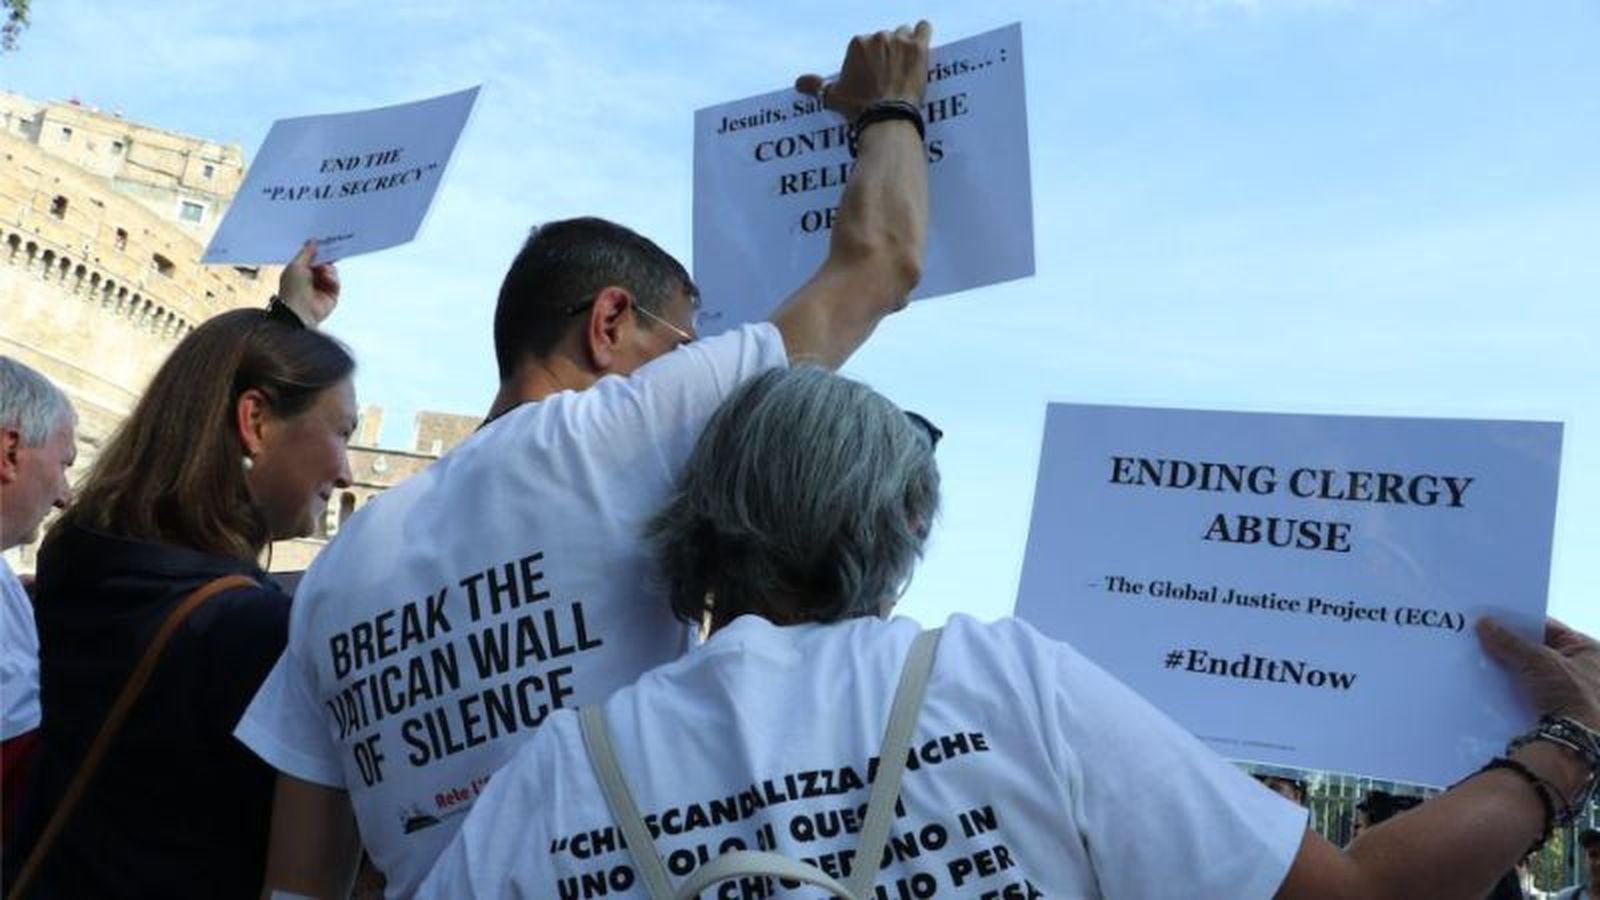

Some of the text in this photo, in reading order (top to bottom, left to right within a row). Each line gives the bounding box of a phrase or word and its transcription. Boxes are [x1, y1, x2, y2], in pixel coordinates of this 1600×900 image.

[262, 163, 438, 201] “PAPAL SECRECY”
[319, 148, 404, 173] END THE
[1108, 456, 1475, 508] ENDING CLERGY
[1204, 512, 1352, 553] ABUSE
[330, 551, 550, 681] BREAK THE
[1105, 576, 1144, 596] The
[1149, 580, 1217, 604] Global
[1221, 588, 1301, 612] Justice
[1306, 598, 1387, 624] Project
[1394, 606, 1466, 633] (ECA)
[328, 602, 603, 740] VATICAN WALL
[1164, 649, 1358, 692] #EndItNow
[353, 666, 574, 788] OF SILENCE
[959, 805, 998, 839] IN
[557, 864, 635, 900] UNO
[948, 844, 1016, 888] PER
